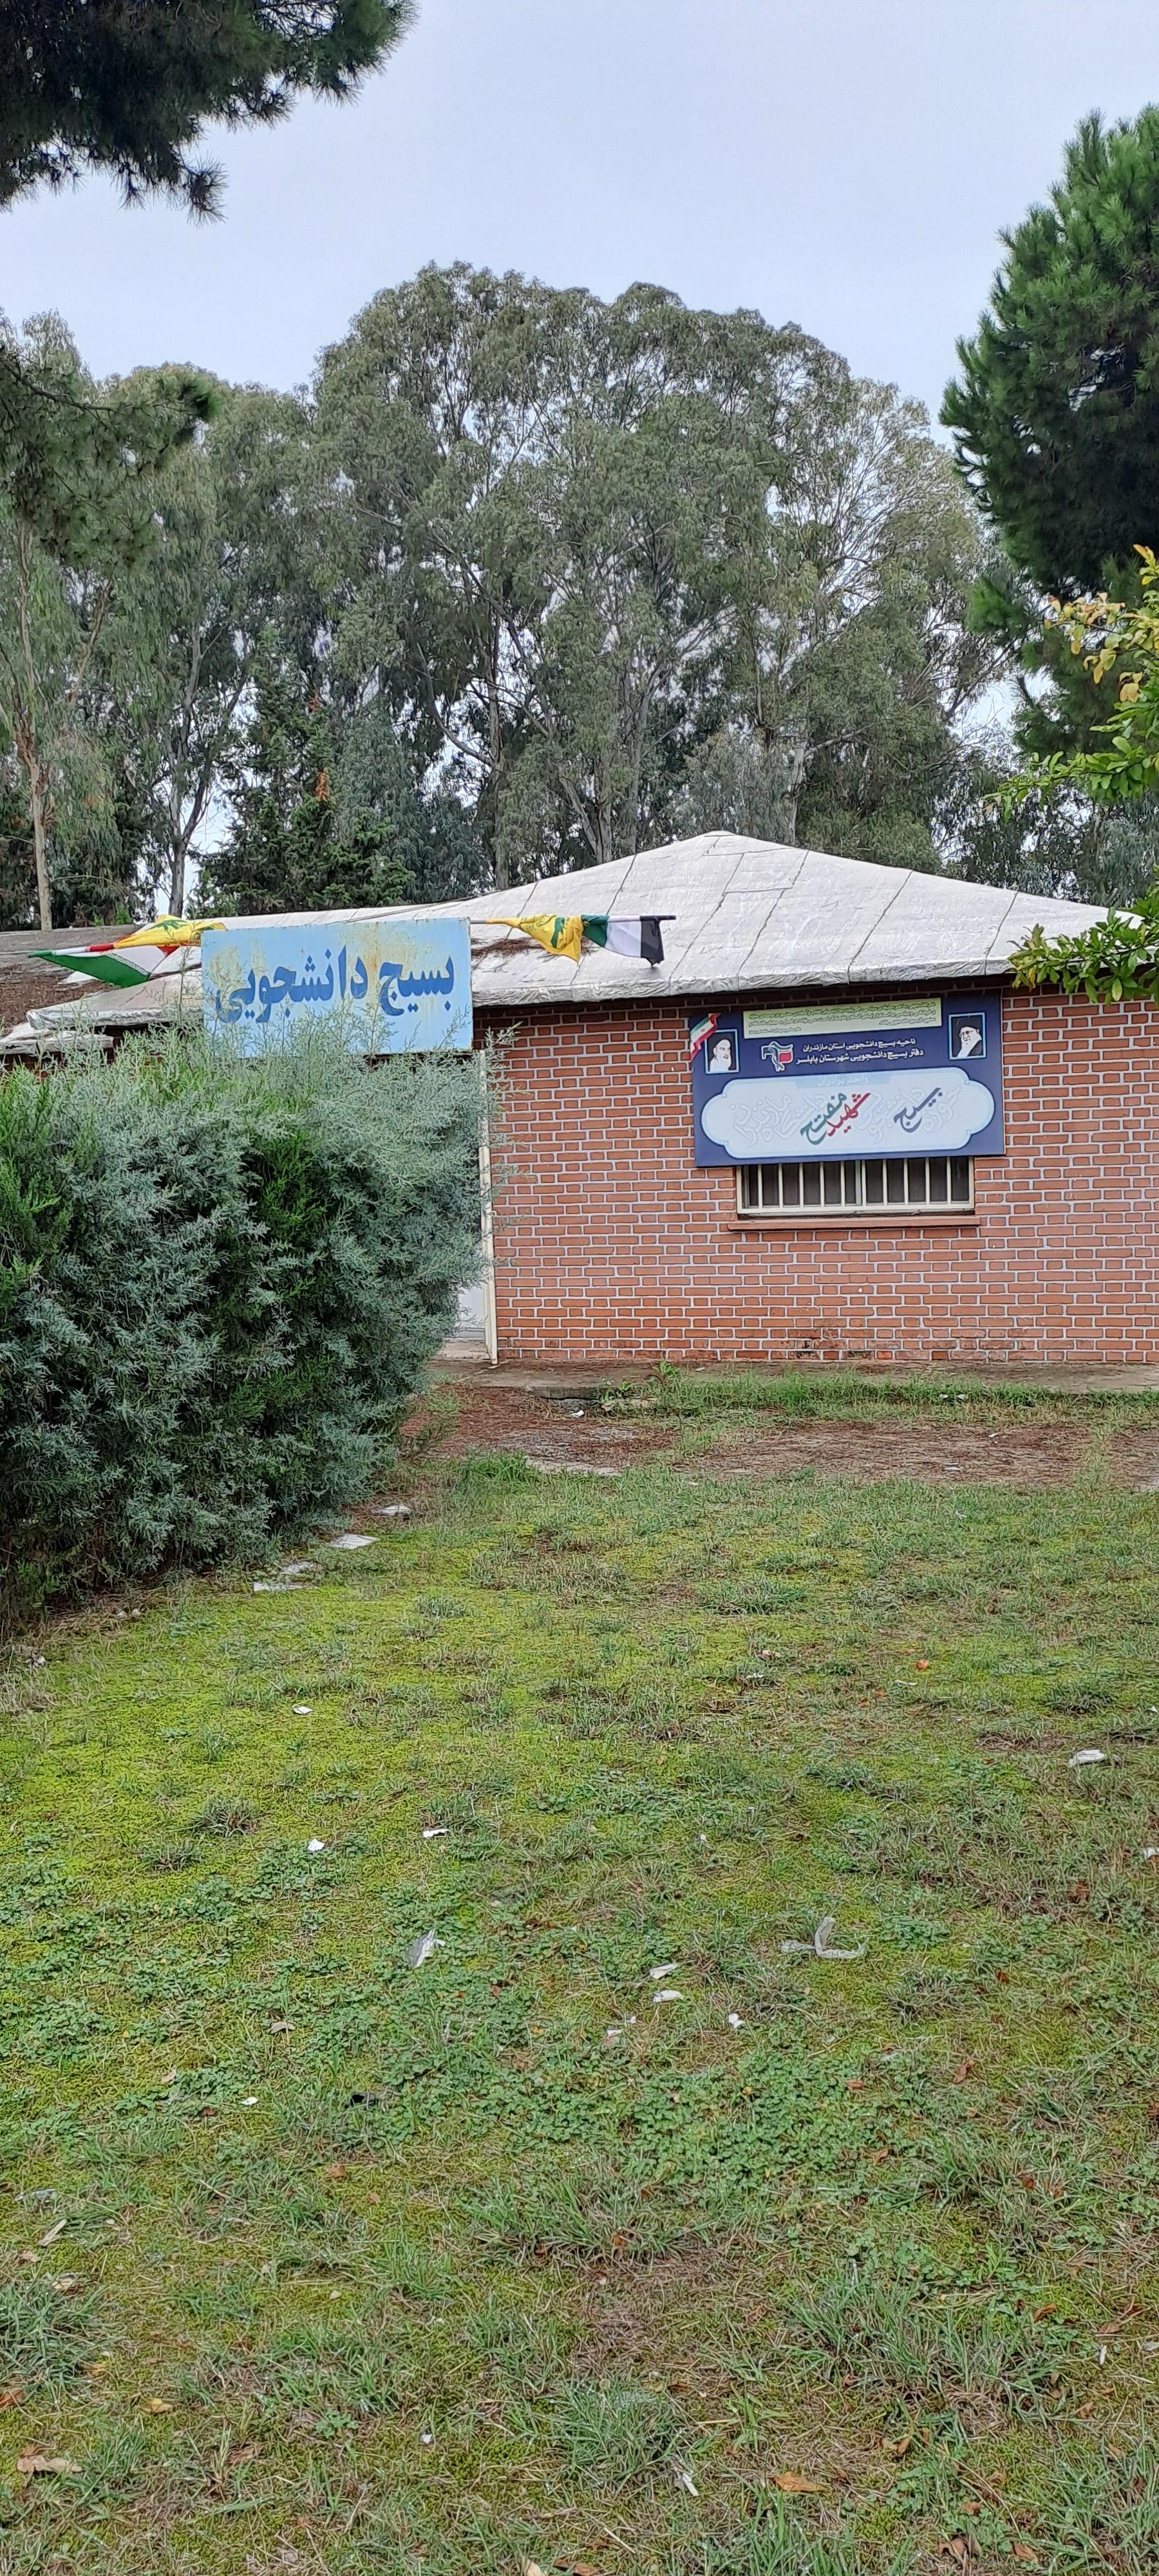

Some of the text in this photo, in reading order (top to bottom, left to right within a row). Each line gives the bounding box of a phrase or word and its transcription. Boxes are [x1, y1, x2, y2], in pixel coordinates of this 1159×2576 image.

[216, 945, 455, 1023] بسیج دانشجویی
[795, 1048, 924, 1065] دفتر بسیج دانشجویی شهرستان بابلسر
[803, 1037, 916, 1053] ناحیه بسیج دانشجویی استان مازندران
[817, 1075, 869, 1087] واحد برادران
[799, 1093, 847, 1145] مفتح
[826, 1093, 871, 1137] شهید
[893, 1087, 943, 1133] بسیج
